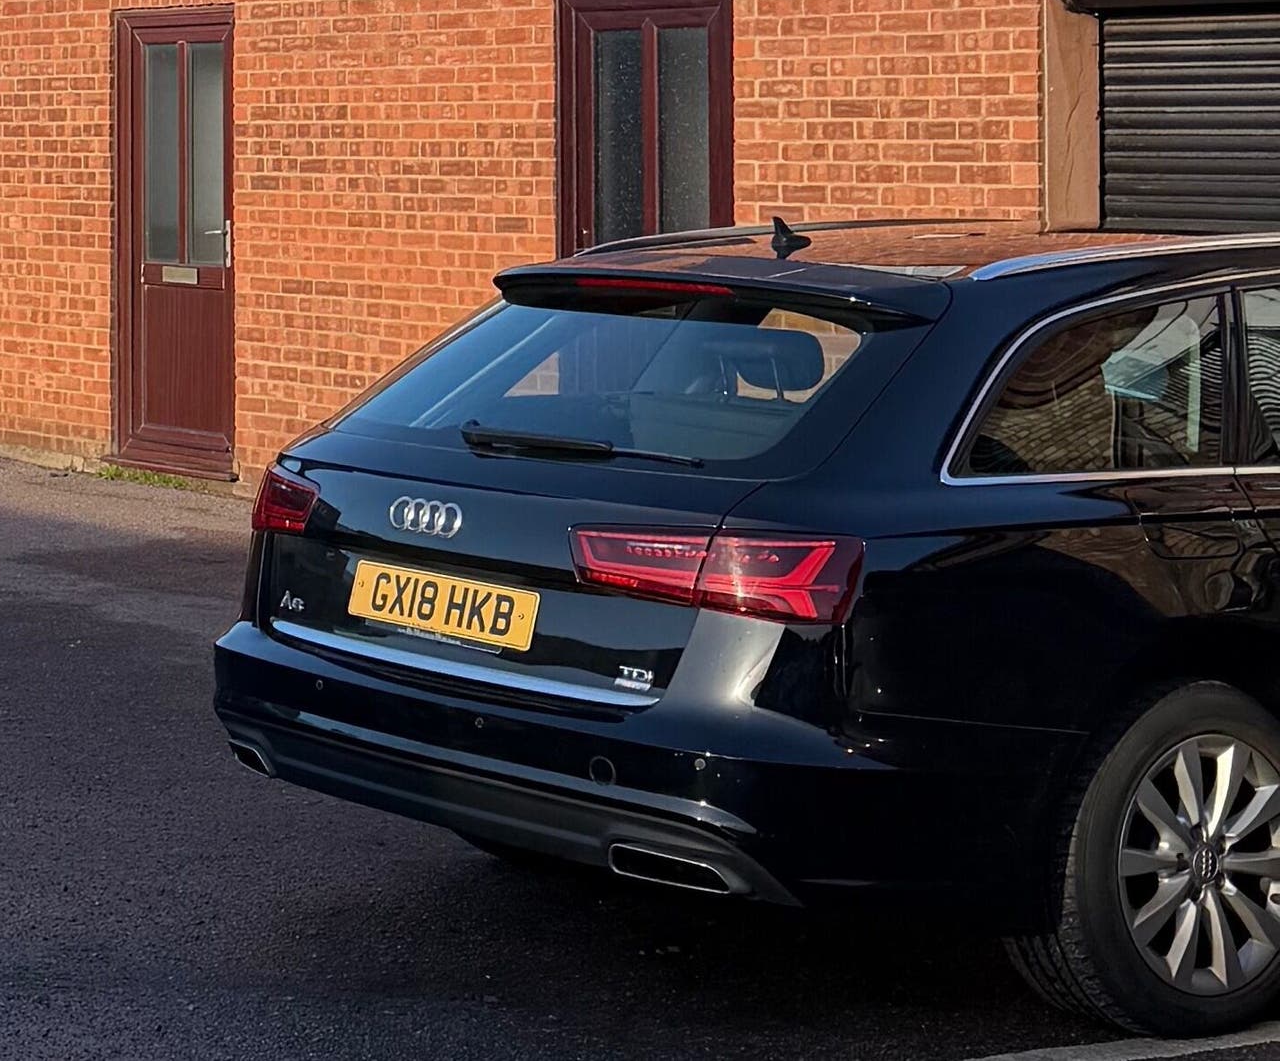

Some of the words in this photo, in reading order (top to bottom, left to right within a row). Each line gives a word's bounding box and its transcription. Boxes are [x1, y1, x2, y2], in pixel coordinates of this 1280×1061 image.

[280, 590, 305, 612] A6
[371, 572, 439, 621] GX18
[444, 584, 515, 637] HKB
